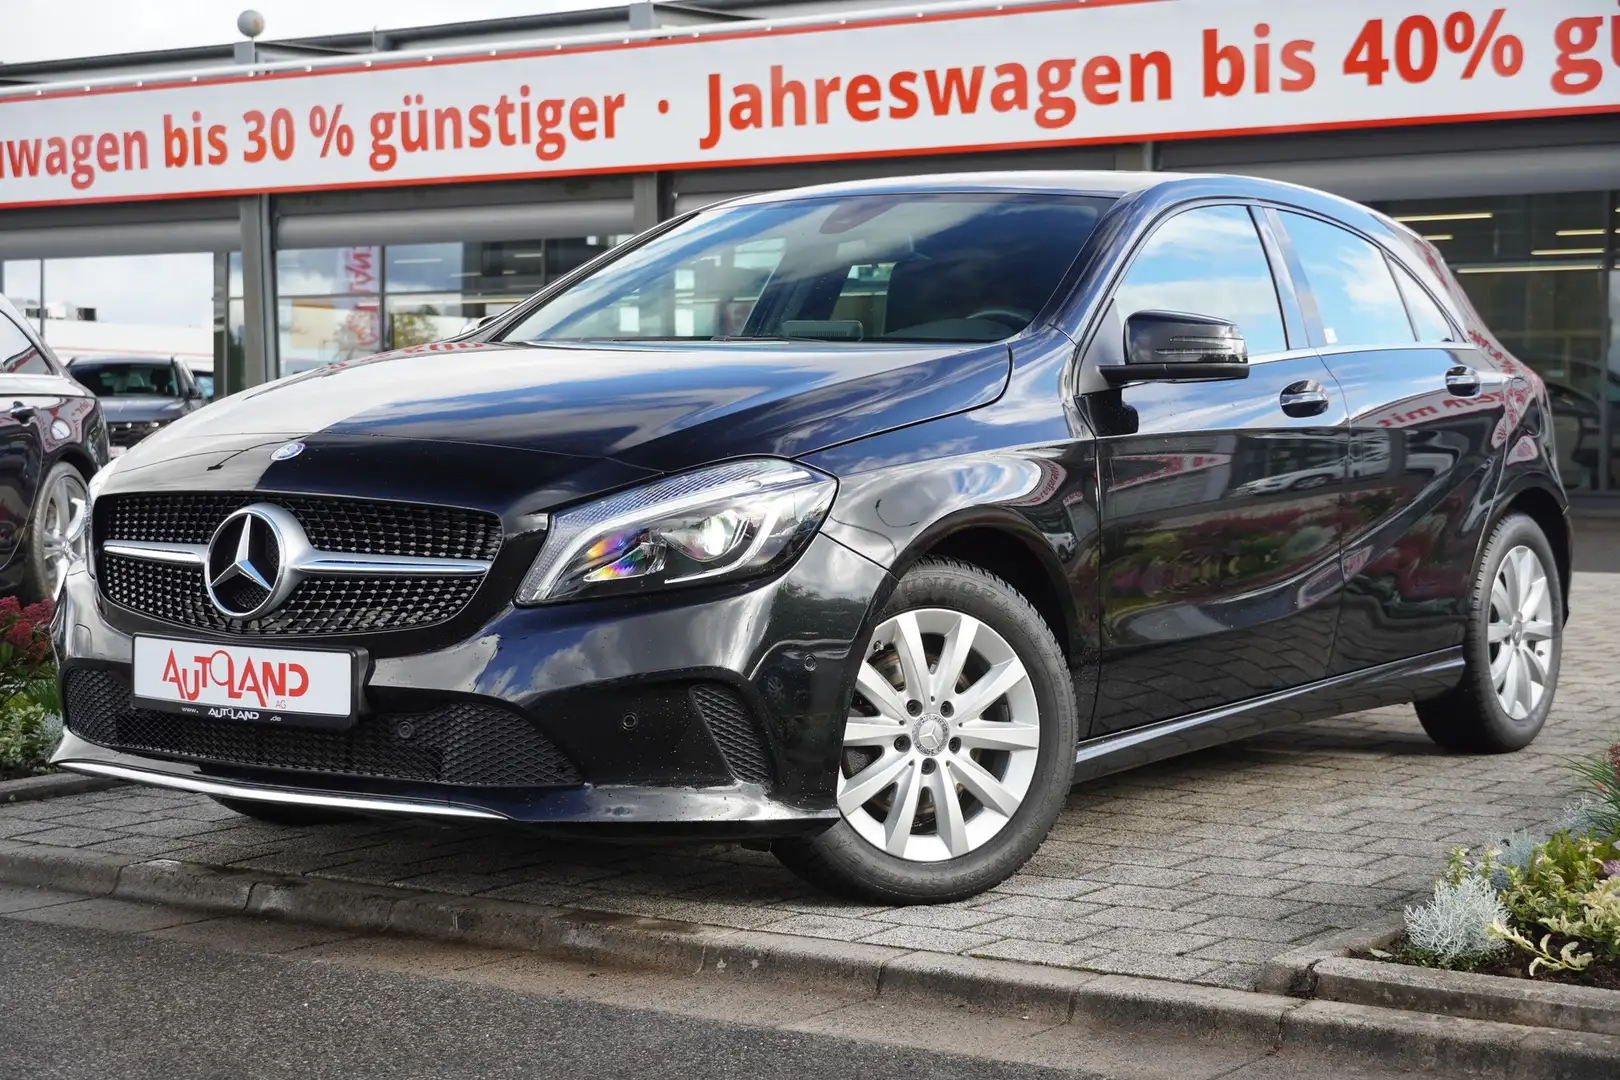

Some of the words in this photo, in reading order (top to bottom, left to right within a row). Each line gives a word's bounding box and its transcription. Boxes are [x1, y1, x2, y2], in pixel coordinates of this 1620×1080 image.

[163, 111, 229, 168] bis
[242, 108, 295, 163] 30
[309, 104, 354, 159] %
[368, 84, 626, 172] günstiger
[698, 50, 1173, 151] Jahreswagen
[1202, 23, 1316, 99] bis
[1342, 8, 1525, 87] 40%
[162, 648, 309, 707] AUTOLAND
[208, 707, 260, 721] AUTOLAND
[276, 700, 287, 709] AG
